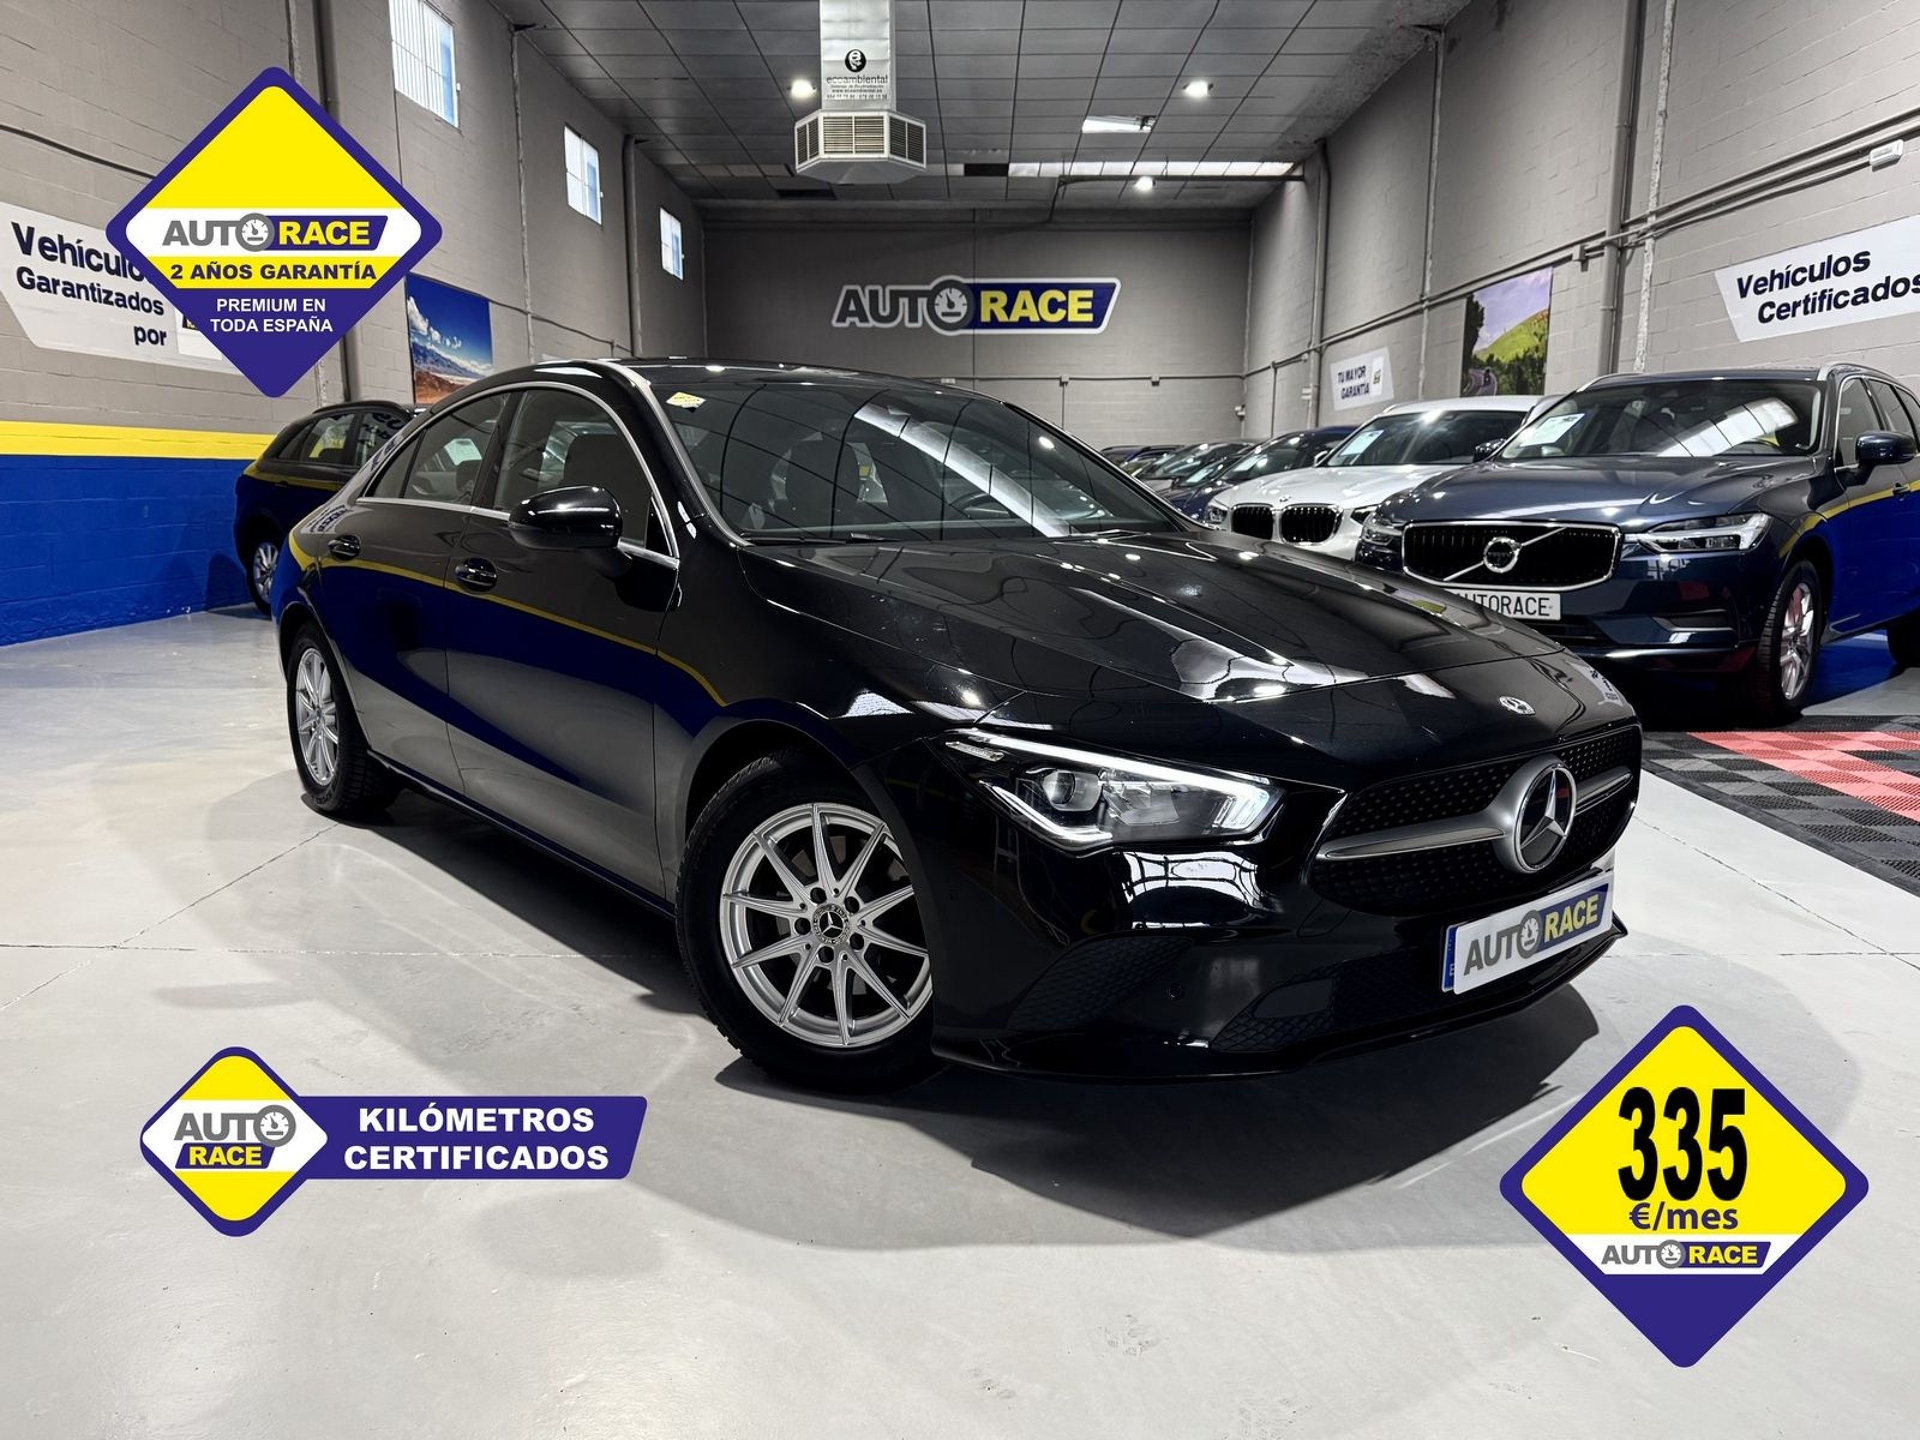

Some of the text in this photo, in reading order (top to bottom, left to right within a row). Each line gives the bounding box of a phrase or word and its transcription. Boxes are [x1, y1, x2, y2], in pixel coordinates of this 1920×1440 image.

[11, 221, 144, 282] Vehículo
[1737, 251, 1871, 298] Vehículos
[16, 266, 165, 316] Garantizados
[133, 326, 167, 346] por
[1457, 593, 1550, 616] TORACE
